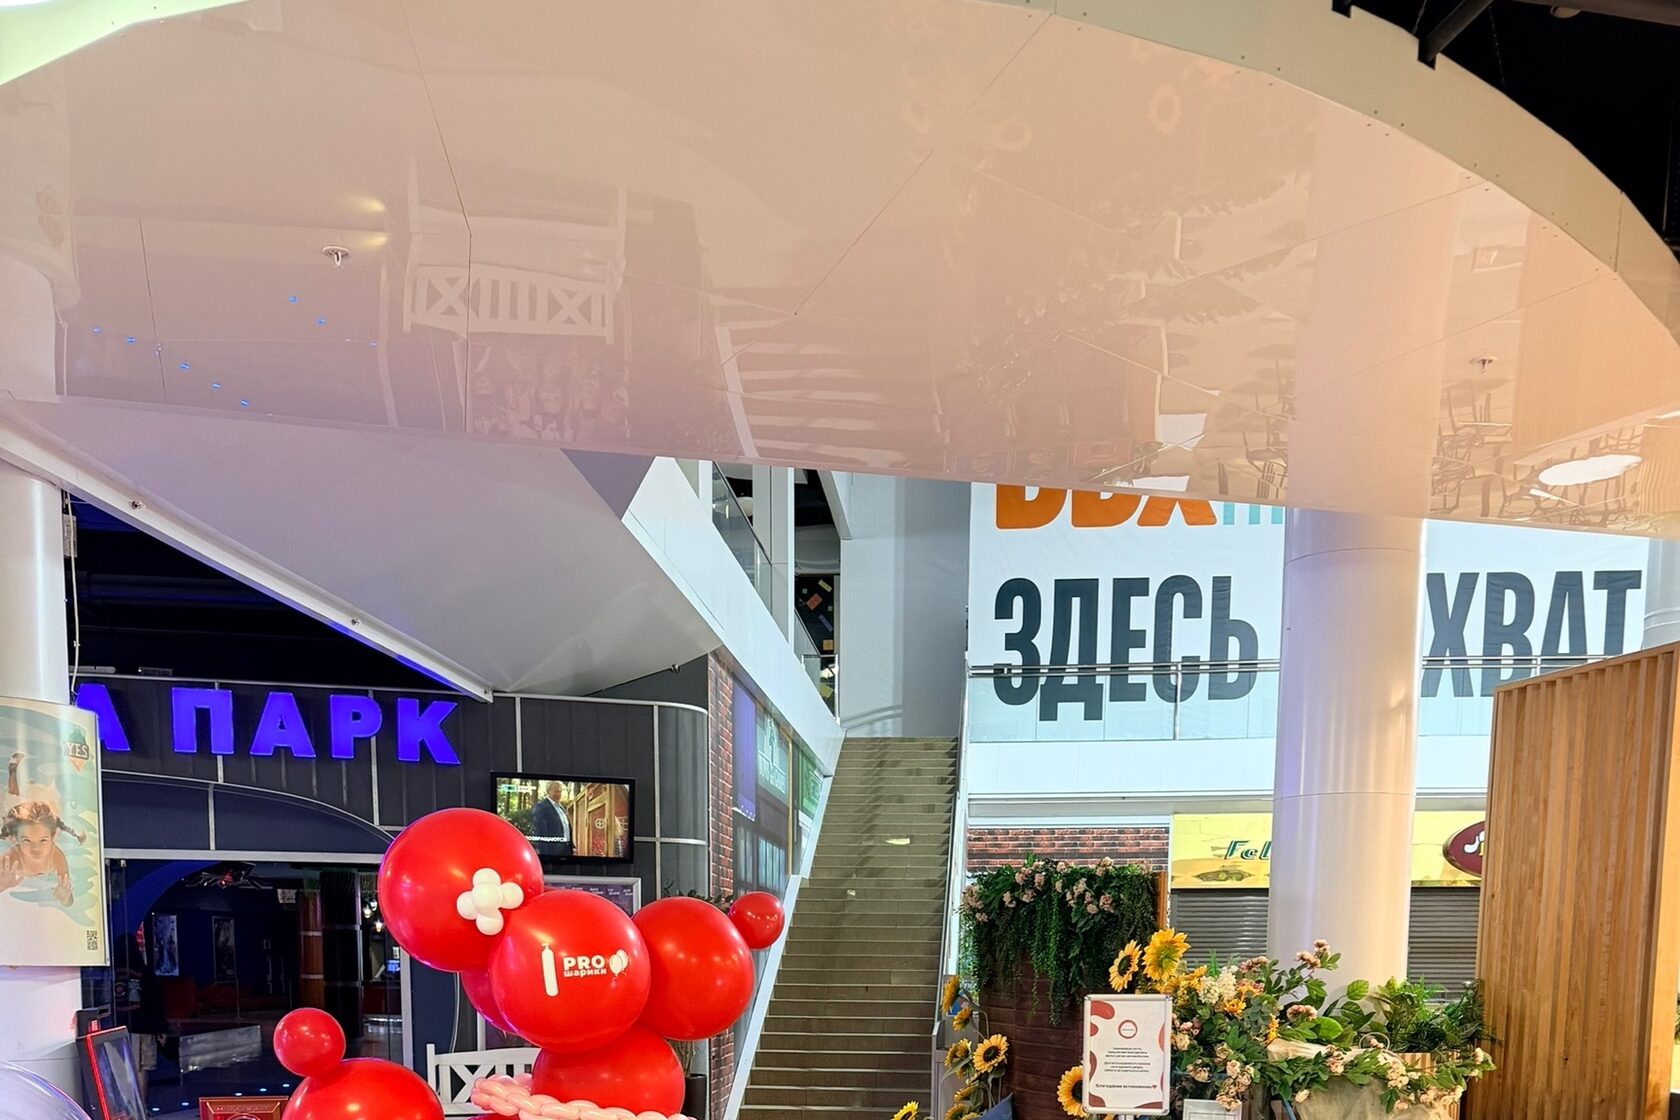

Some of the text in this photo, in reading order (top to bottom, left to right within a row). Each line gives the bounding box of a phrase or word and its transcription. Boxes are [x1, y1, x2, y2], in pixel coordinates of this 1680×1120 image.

[993, 574, 1259, 721] ЗДЕСЬ
[171, 686, 462, 765] ПАРК
[563, 955, 605, 970] PRO
[564, 968, 607, 977] шарики
